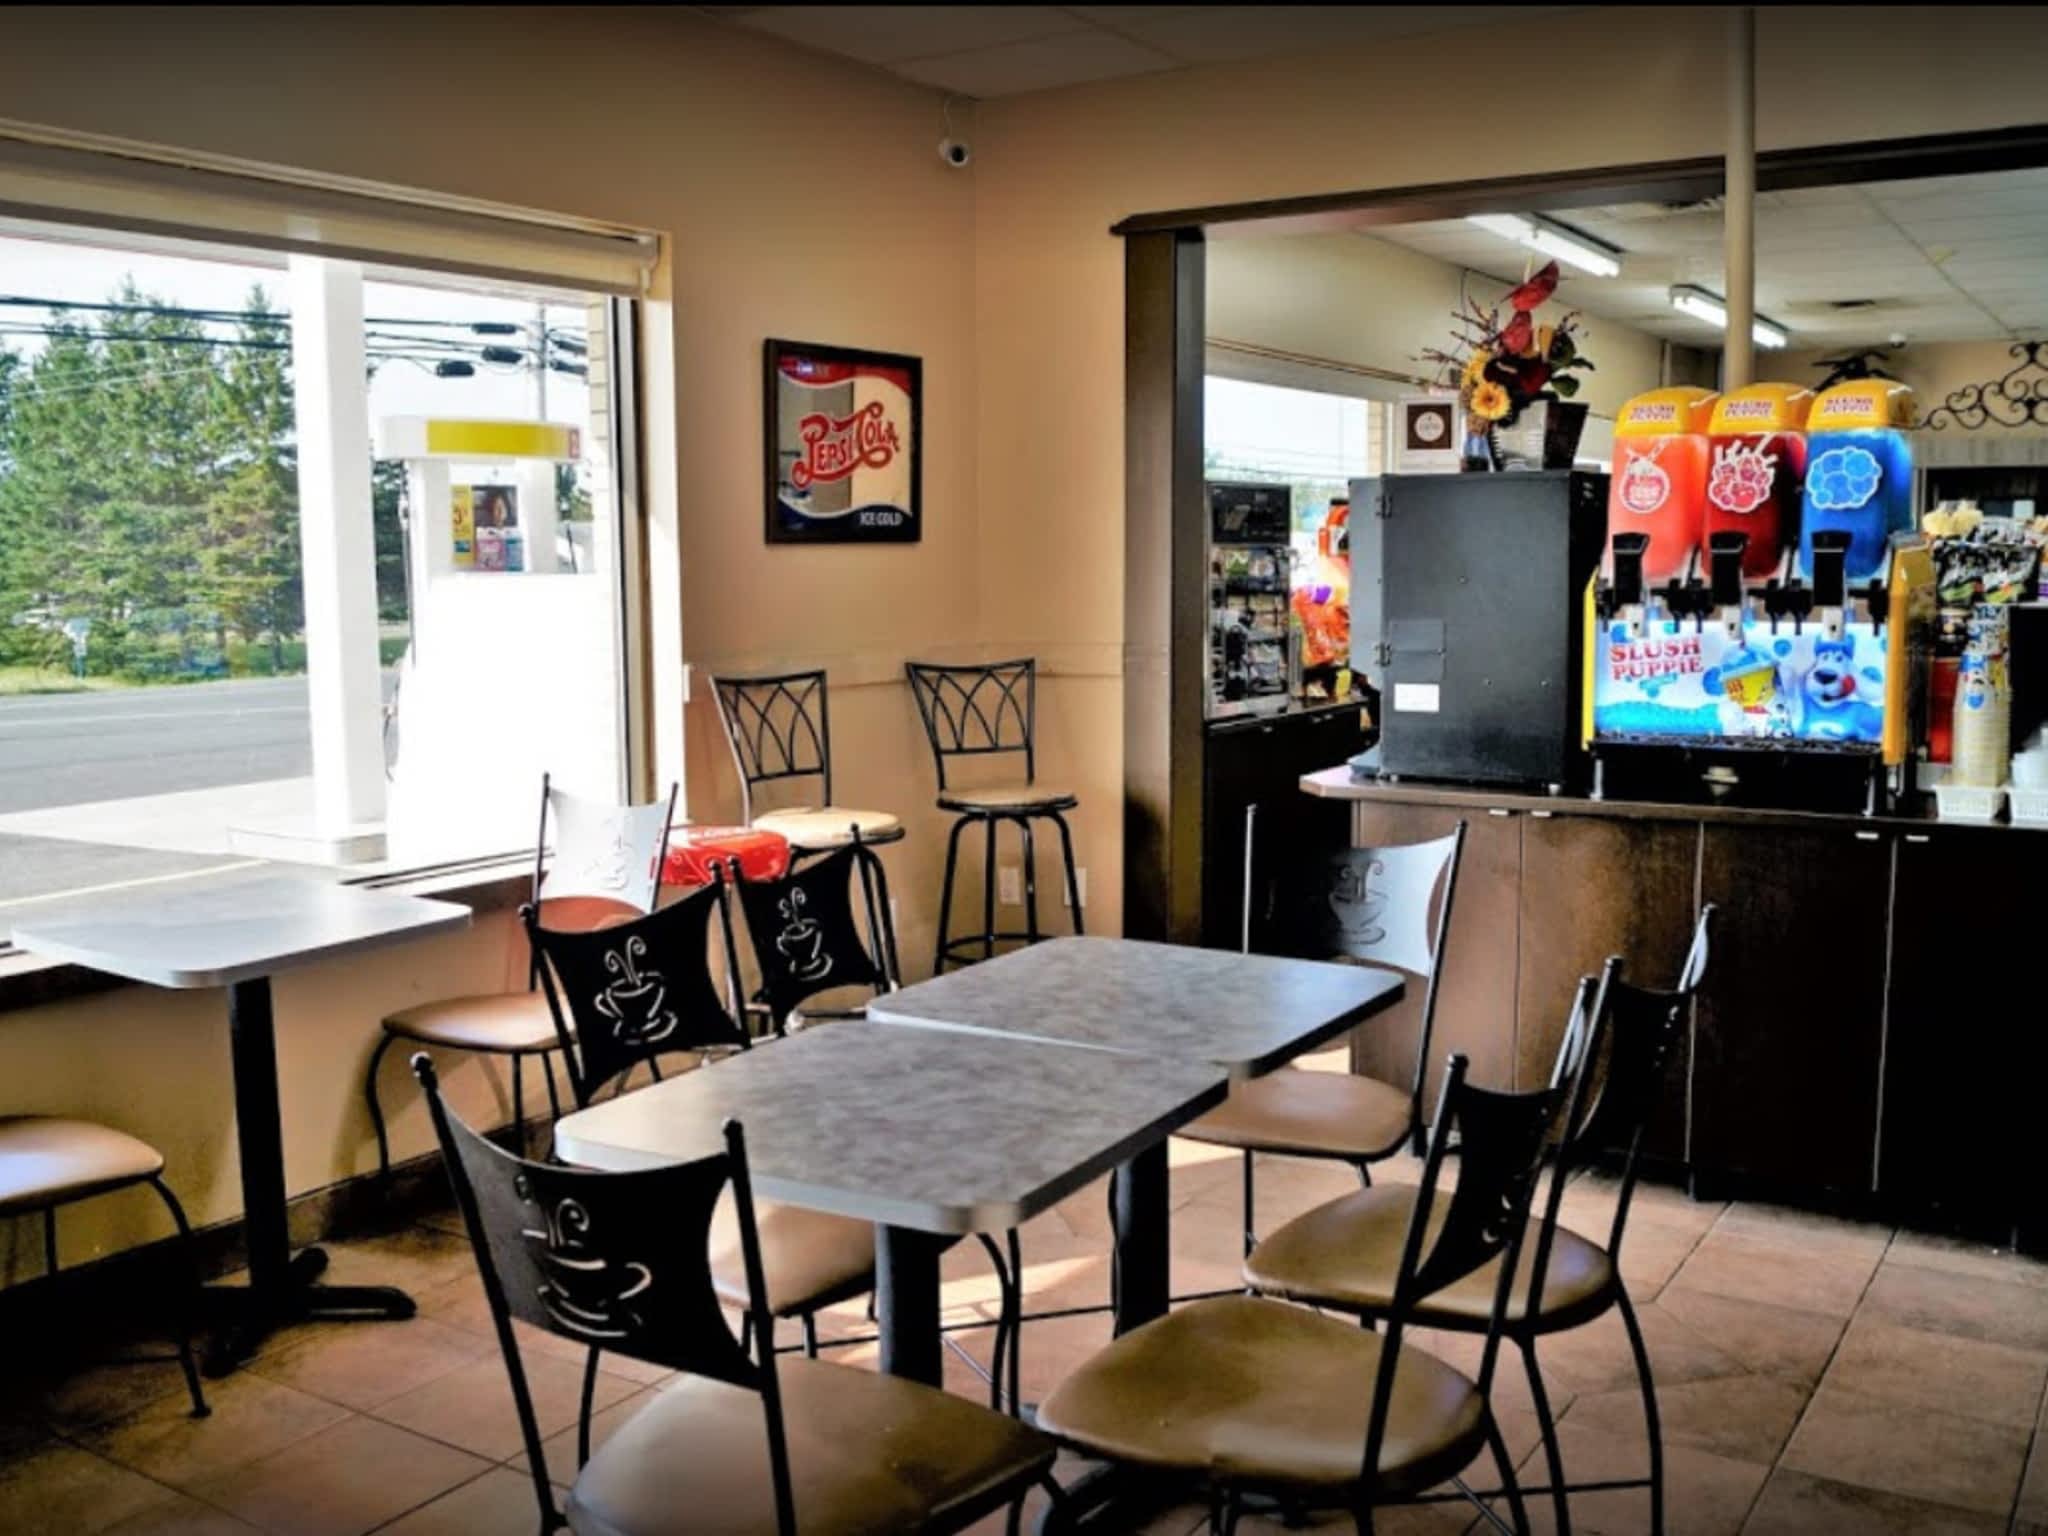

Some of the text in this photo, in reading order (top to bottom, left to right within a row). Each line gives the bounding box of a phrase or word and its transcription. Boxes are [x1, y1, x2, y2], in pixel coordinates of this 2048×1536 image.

[877, 511, 903, 526] COLD
[1610, 637, 1701, 662] SLUSH
[1612, 656, 1704, 681] PUPPIE
